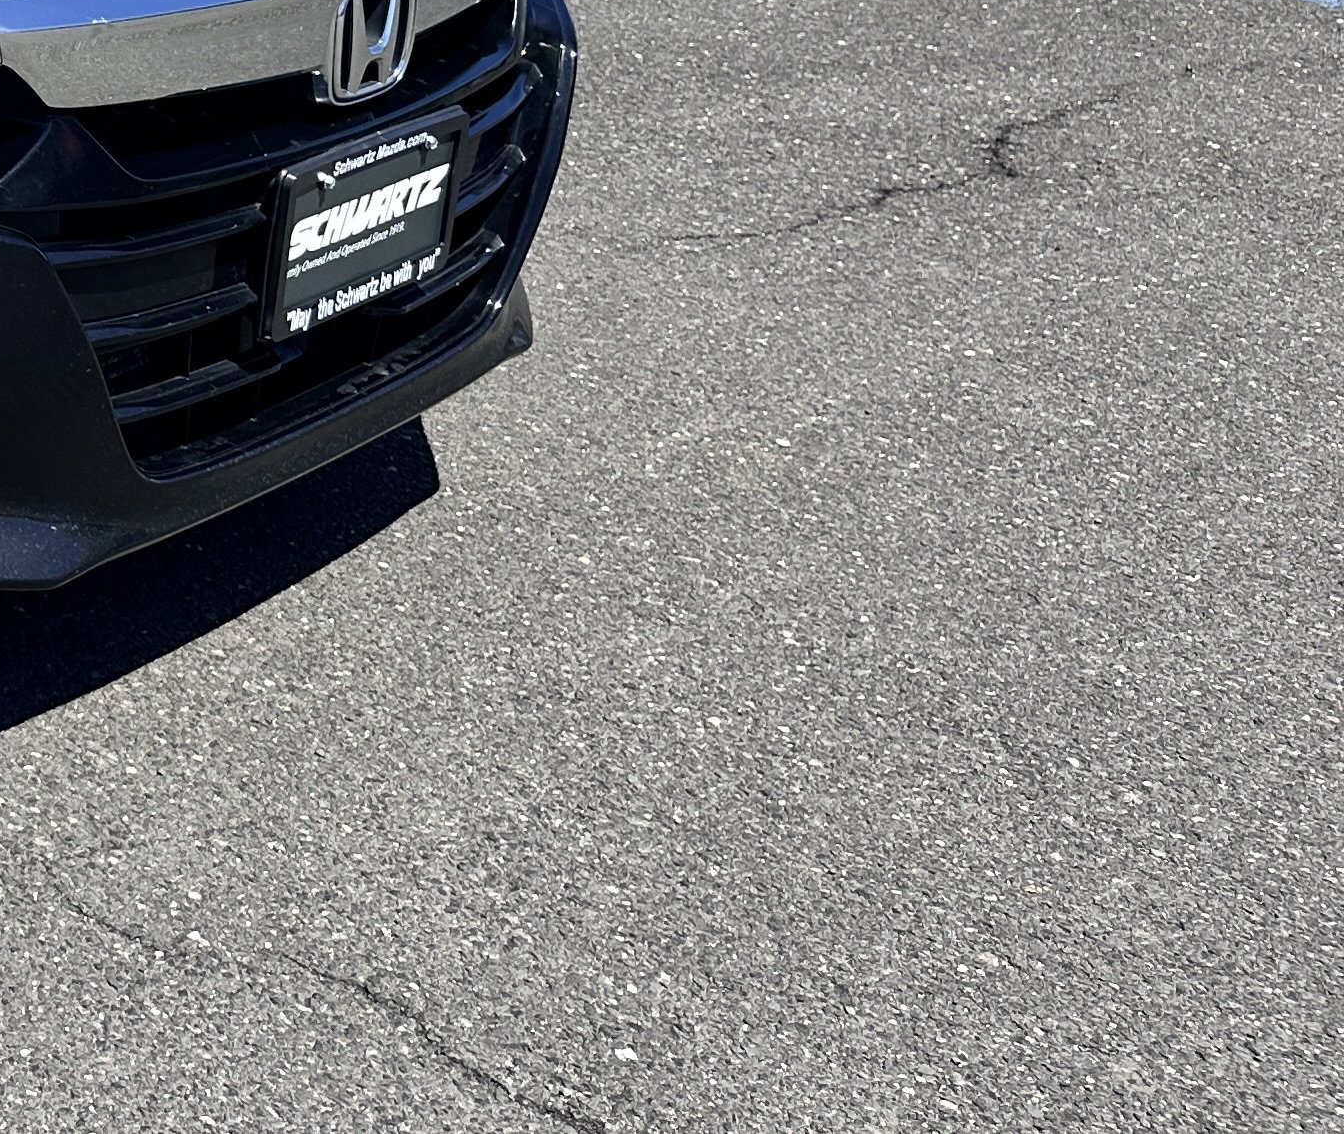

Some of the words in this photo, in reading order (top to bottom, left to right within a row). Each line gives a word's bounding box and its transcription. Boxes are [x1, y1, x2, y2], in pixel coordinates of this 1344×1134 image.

[333, 149, 377, 176] Schwartz
[288, 163, 450, 261] SCHWARTZ
[317, 297, 335, 320] the
[335, 276, 380, 312] Schwartz
[379, 272, 393, 292] be
[393, 260, 413, 286] with
